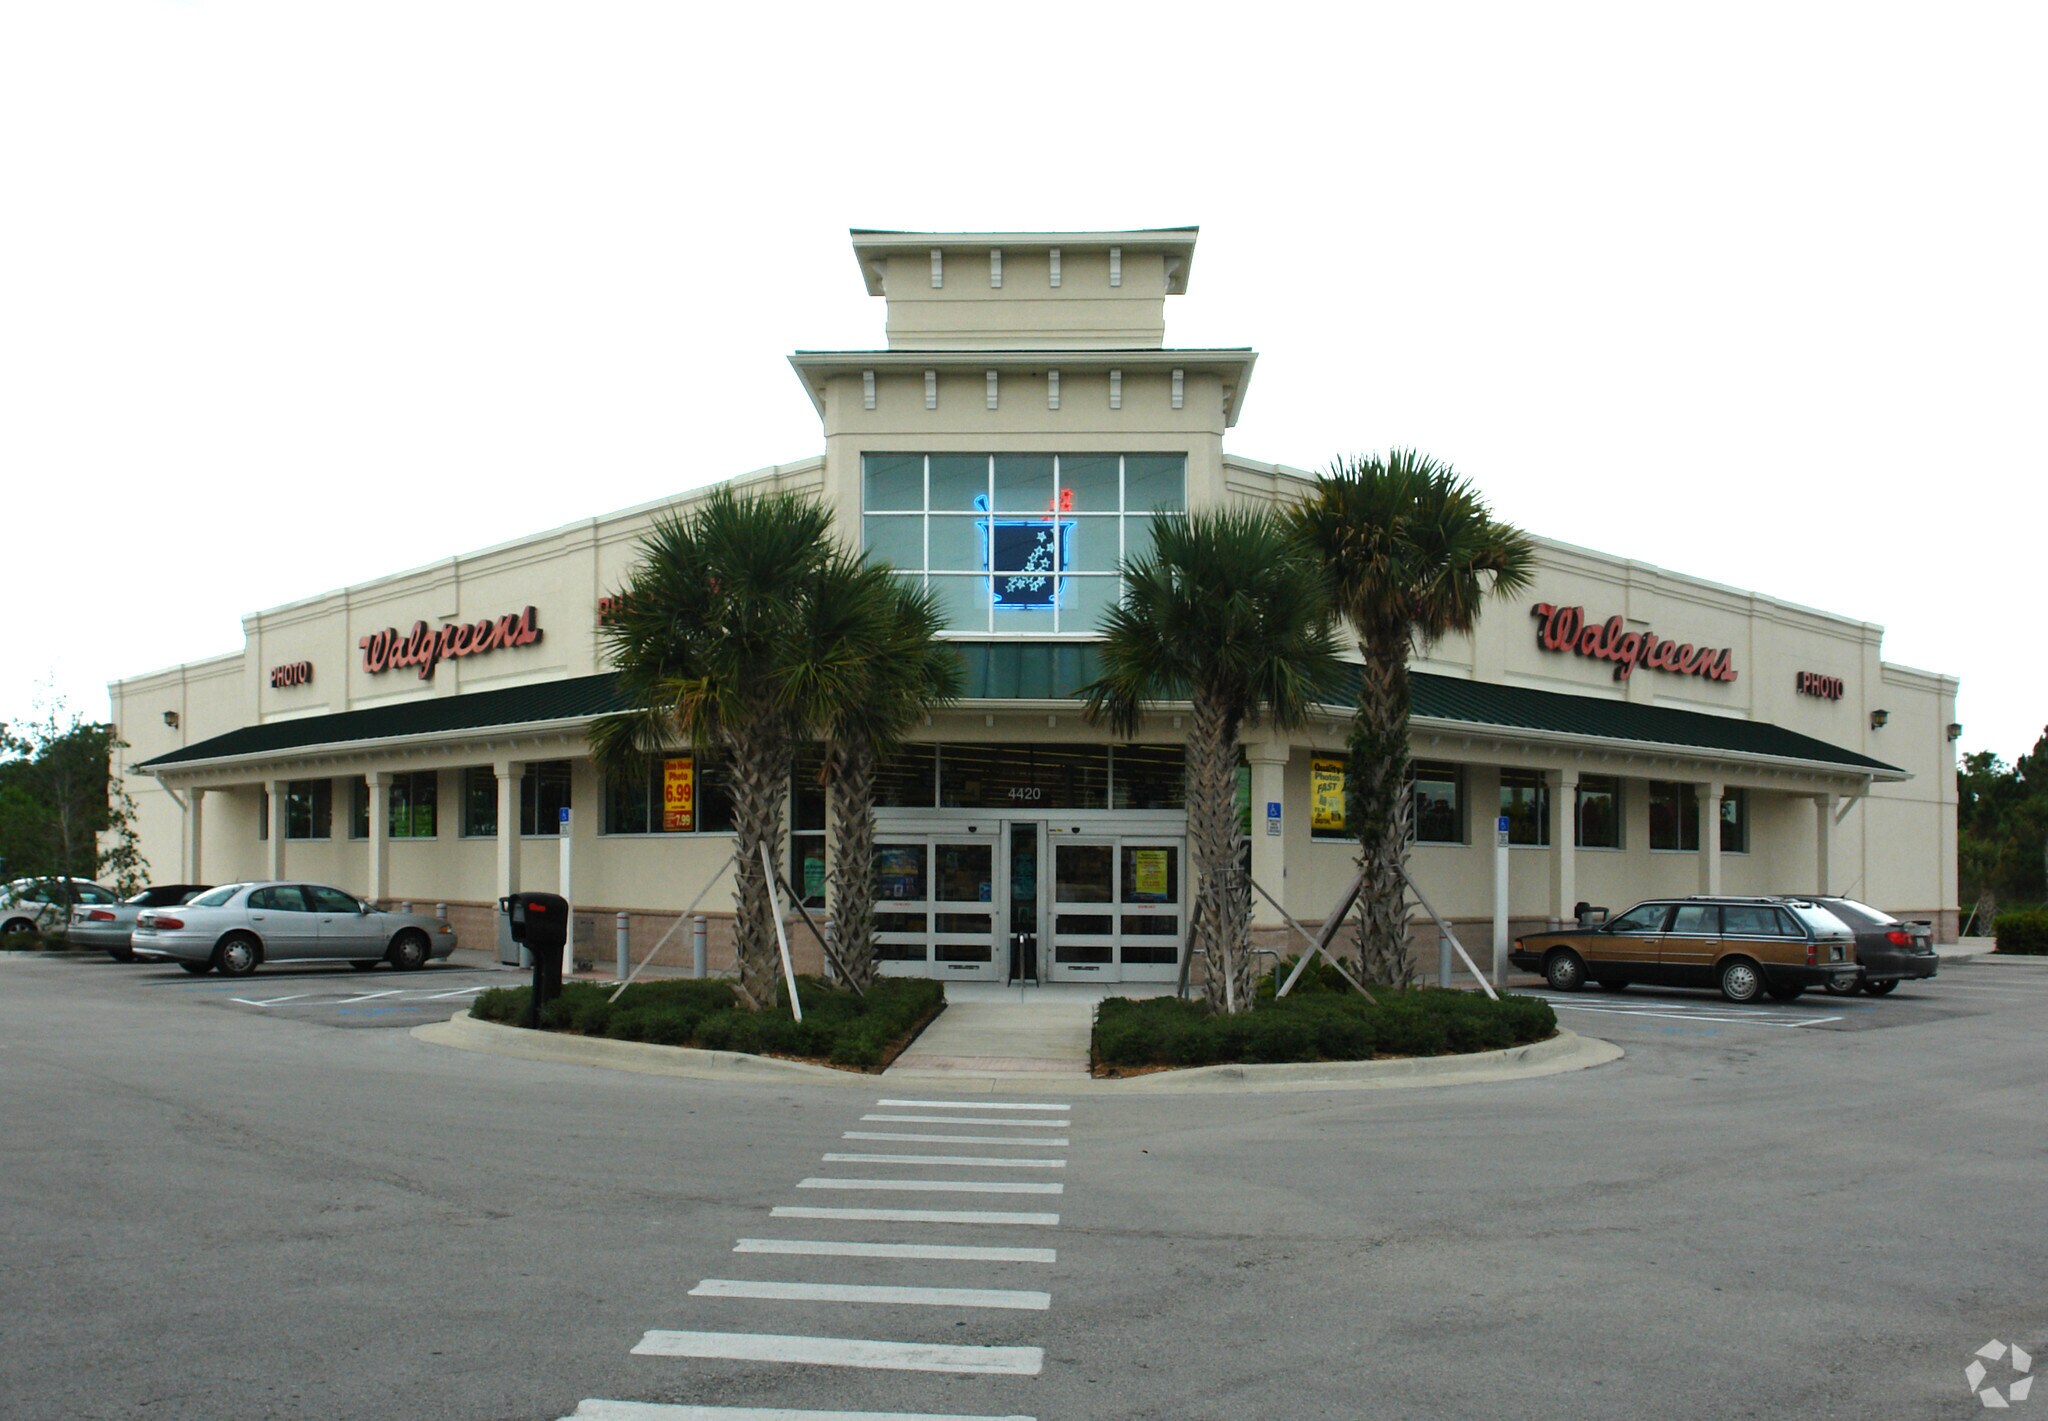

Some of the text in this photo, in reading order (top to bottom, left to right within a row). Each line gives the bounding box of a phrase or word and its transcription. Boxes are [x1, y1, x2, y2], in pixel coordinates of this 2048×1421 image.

[359, 606, 543, 680] Walgreens
[1532, 602, 1738, 681] Walgreens
[271, 661, 313, 688] PHOTO
[1796, 671, 1843, 700] PHOTO
[1314, 763, 1343, 774] Quality
[669, 772, 688, 781] Photo
[666, 784, 691, 802] 6.99
[1008, 787, 1041, 800] 4420
[1317, 783, 1337, 794] FAST
[675, 814, 691, 827] 7.99
